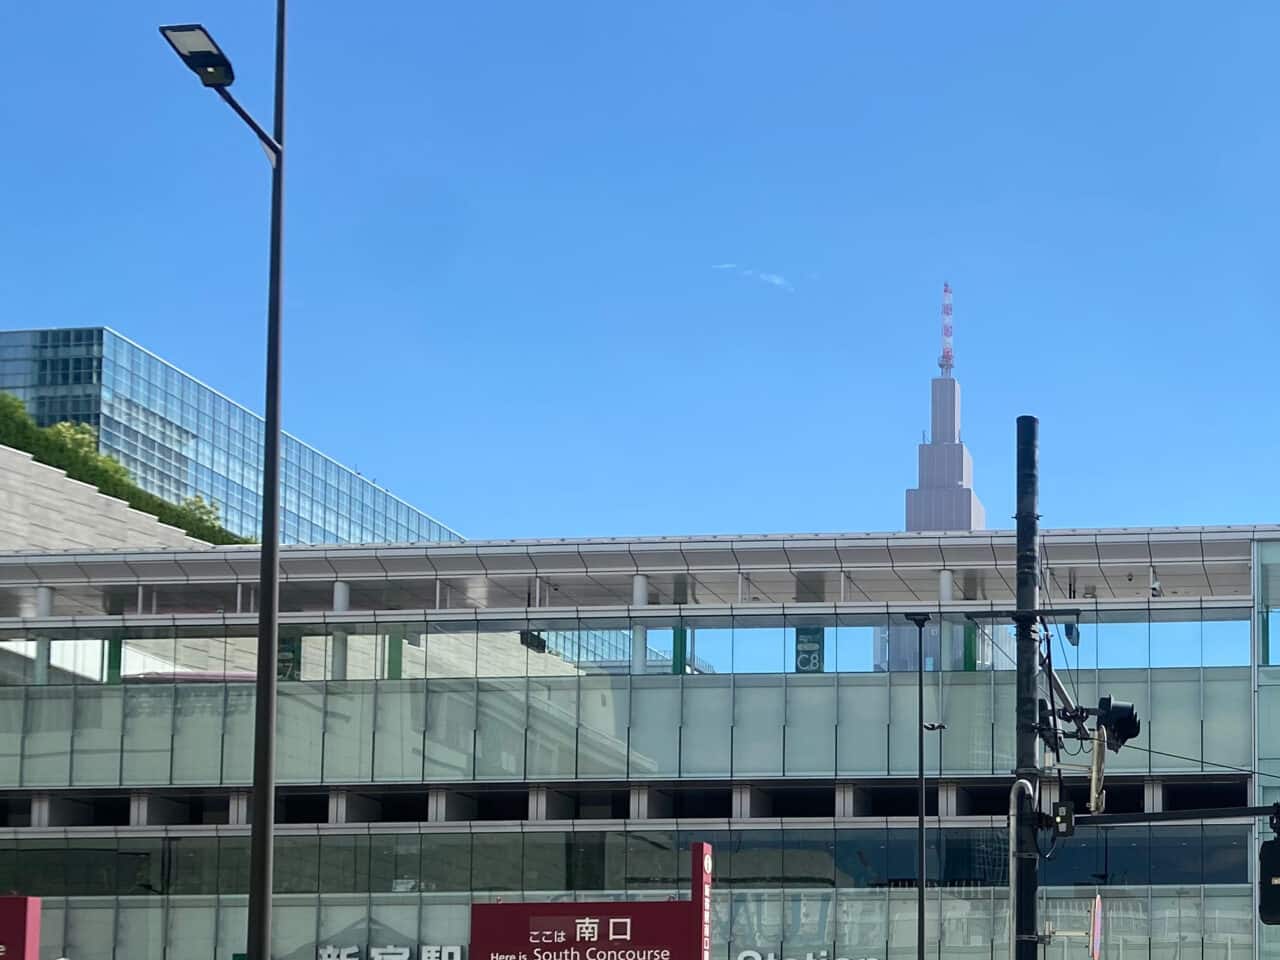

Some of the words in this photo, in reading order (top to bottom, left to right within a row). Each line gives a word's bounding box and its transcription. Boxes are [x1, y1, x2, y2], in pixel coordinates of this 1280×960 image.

[797, 653, 820, 671] C8
[529, 930, 566, 943] ここは
[575, 917, 632, 942] 南口
